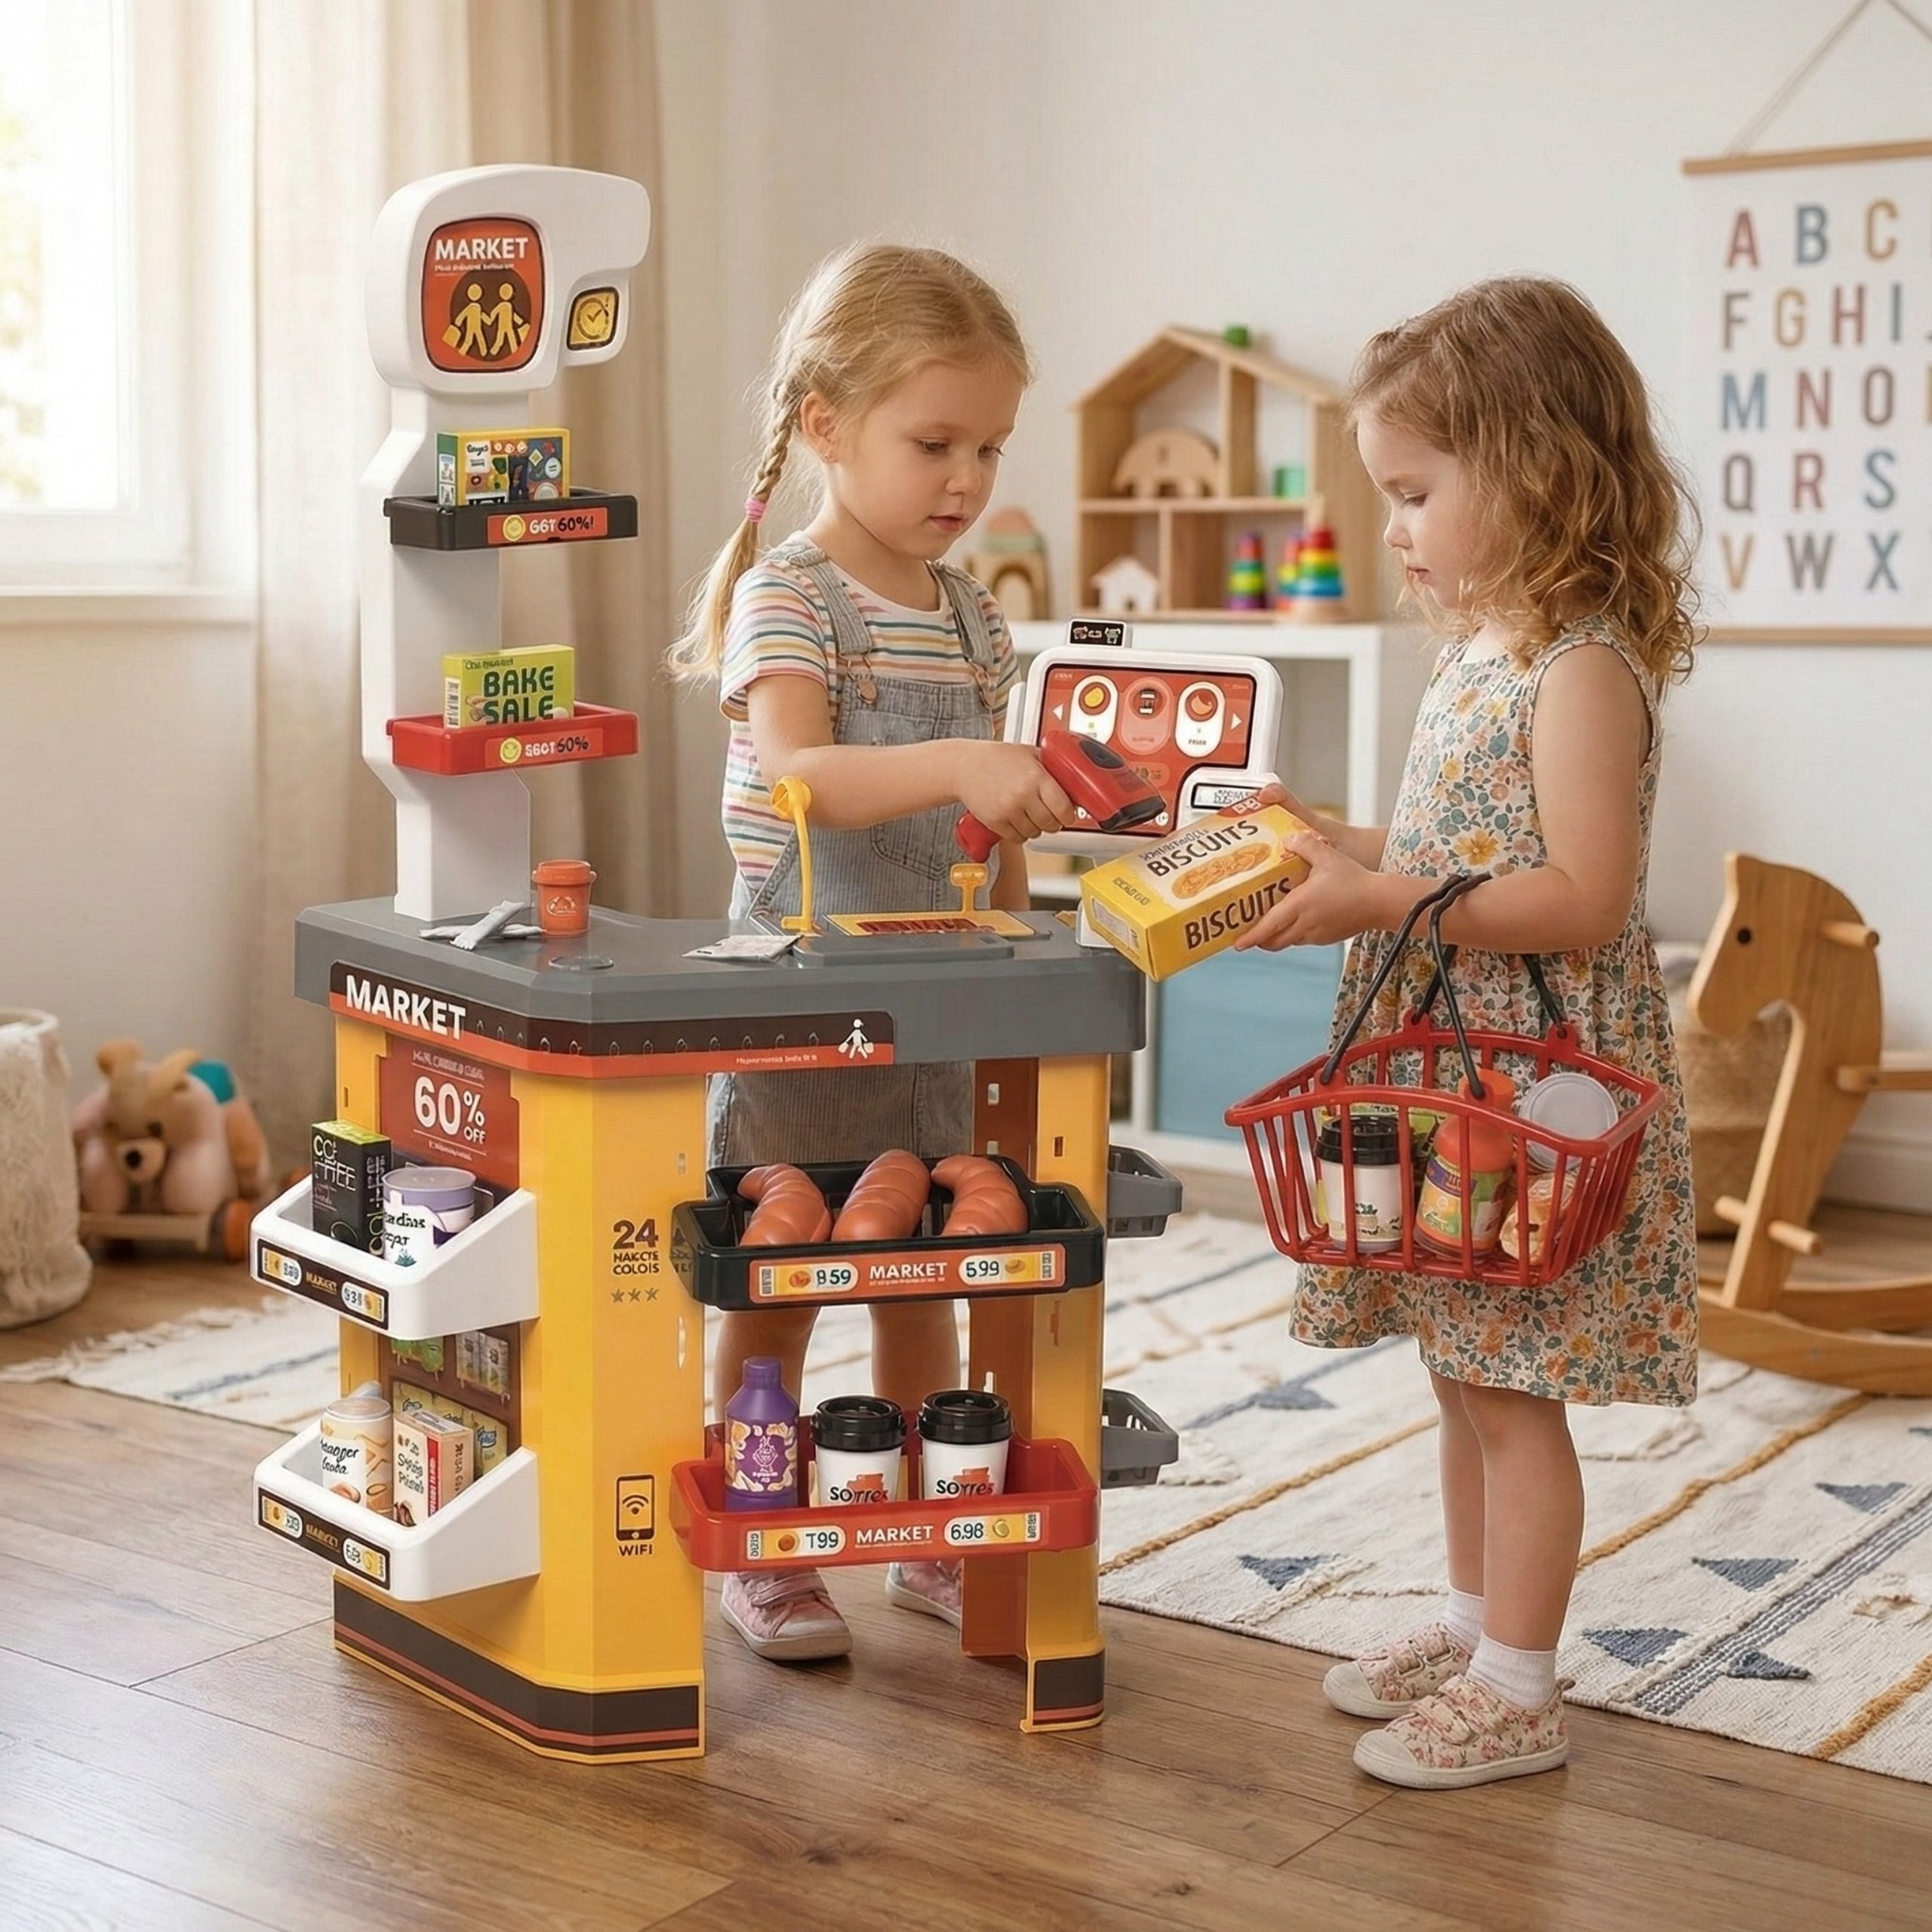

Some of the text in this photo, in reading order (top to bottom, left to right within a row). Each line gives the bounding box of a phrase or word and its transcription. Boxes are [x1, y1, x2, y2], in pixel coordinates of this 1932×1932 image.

[435, 237, 528, 260] MARKET
[1726, 201, 1897, 267] A B C
[1724, 285, 1901, 350] F G H I
[1722, 368, 1894, 429] M N O
[1724, 452, 1895, 512] Q R S
[1722, 535, 1898, 590] V W X
[484, 666, 554, 697] BAKE
[483, 695, 553, 724] SALE
[1147, 820, 1258, 876] BISCUITS
[346, 975, 466, 1041] MARKET
[415, 1076, 485, 1135] 60%
[463, 1126, 486, 1145] OFF
[613, 1218, 659, 1250] 24
[869, 1262, 948, 1280] MARKET
[619, 1544, 653, 1557] WIFI
[855, 1525, 934, 1545] MARKET
